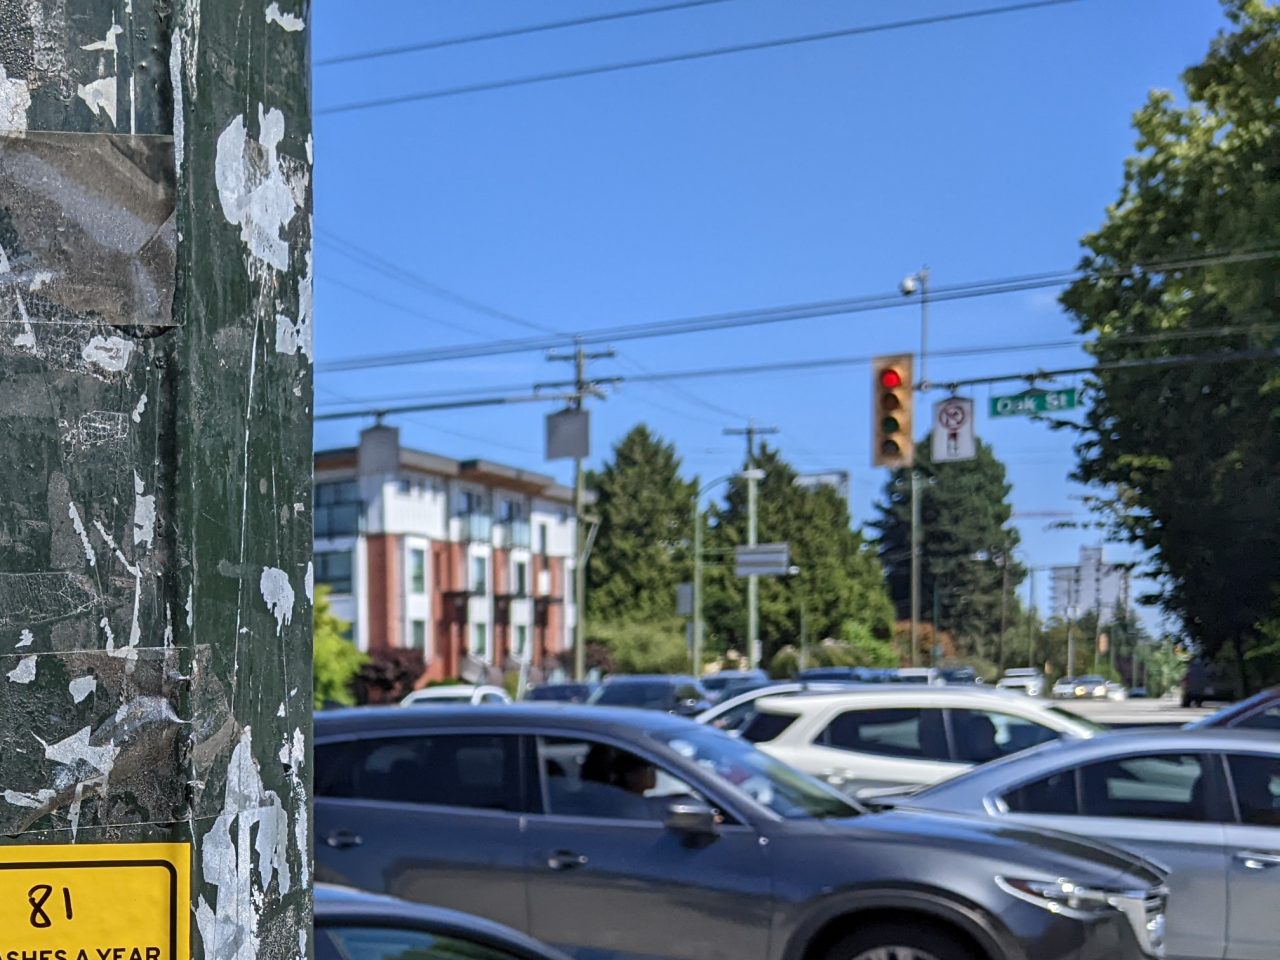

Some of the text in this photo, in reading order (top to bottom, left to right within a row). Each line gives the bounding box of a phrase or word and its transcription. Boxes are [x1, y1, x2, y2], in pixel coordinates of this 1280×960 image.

[997, 391, 1068, 415] Oak St
[28, 885, 72, 928] 81
